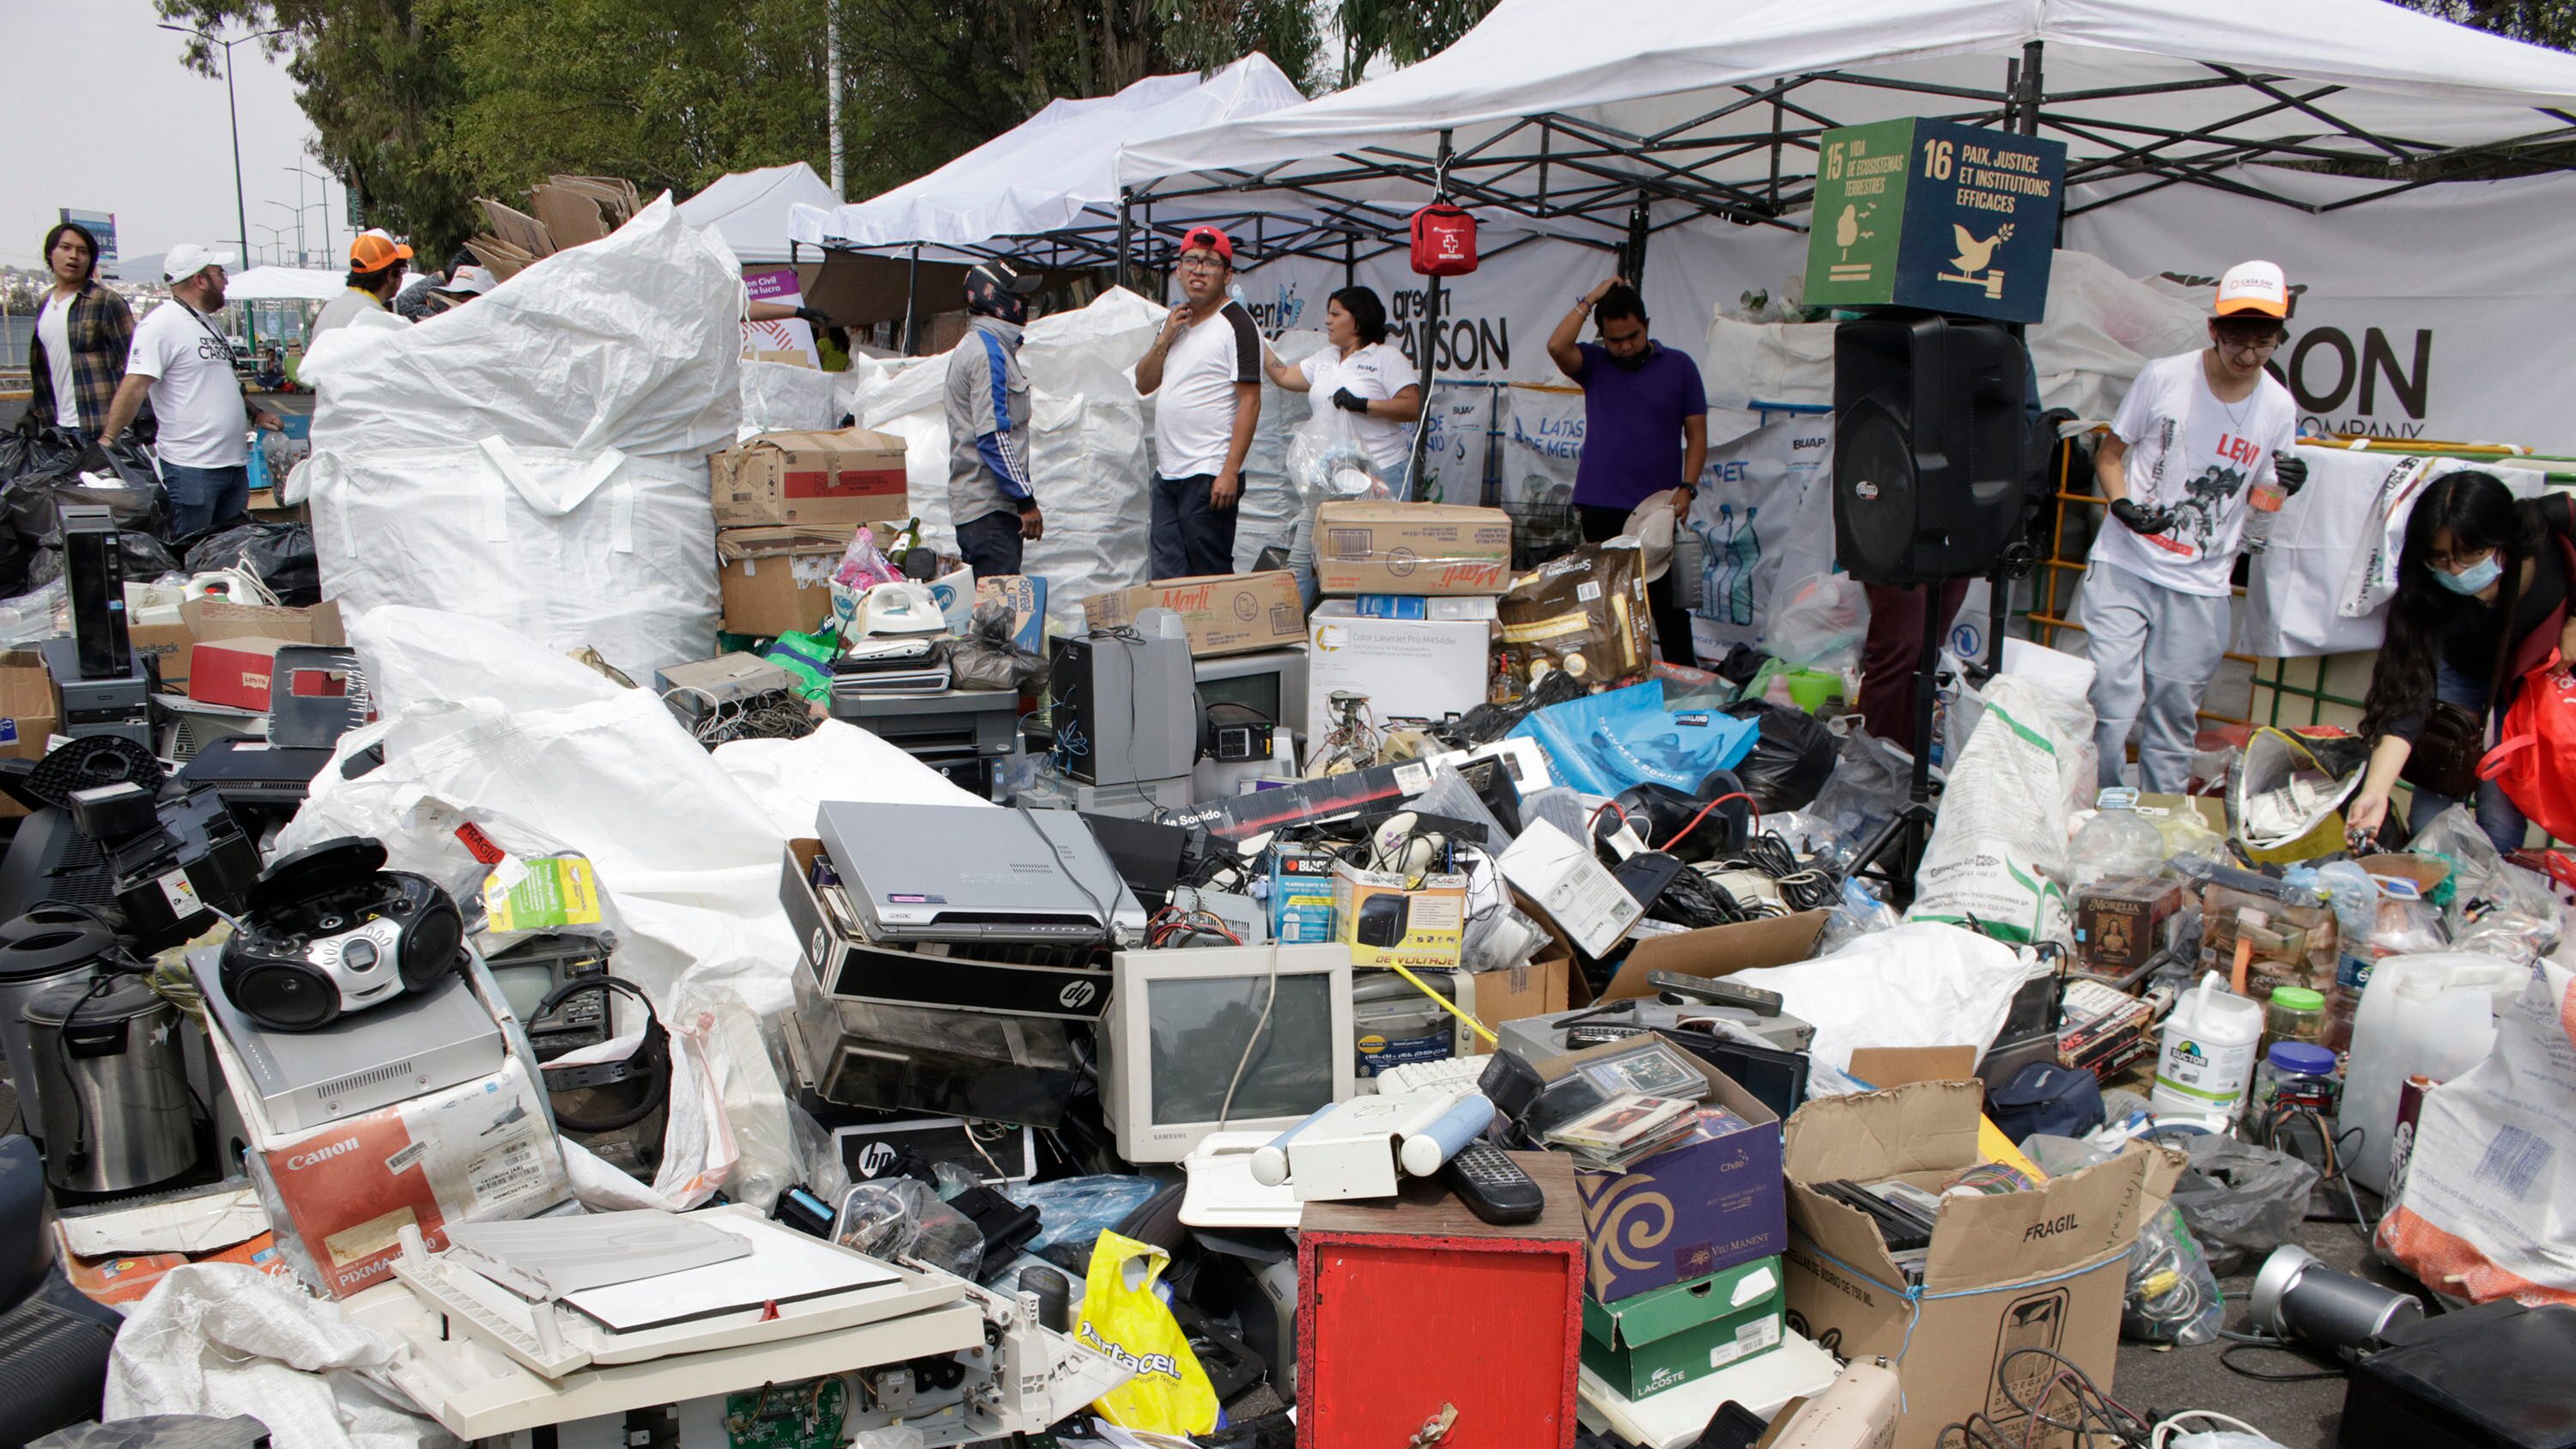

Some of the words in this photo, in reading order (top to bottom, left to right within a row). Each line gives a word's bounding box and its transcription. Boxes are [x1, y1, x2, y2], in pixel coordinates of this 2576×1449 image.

[1826, 143, 1844, 180] 15
[1850, 139, 1866, 158] VIDA
[1846, 160, 1856, 178] DE
[1856, 154, 1904, 174] ECOSISTEMAS
[1924, 138, 1953, 180] 16
[1962, 144, 1991, 167] PAIX,
[1993, 150, 2040, 174] JUSTICE
[1845, 176, 1886, 197] TERRESTRES
[1959, 167, 1974, 185] ET
[1975, 169, 2050, 198] INSTITUTIONS
[1956, 188, 2015, 214] EFFICACES
[758, 275, 777, 286] Civil
[760, 284, 781, 294] lucro
[1393, 288, 1450, 330] gren
[1540, 417, 1584, 437] LATAS
[1547, 441, 1583, 460] MET
[1793, 438, 1826, 450] BUAP
[2216, 433, 2260, 468] LEVI
[1018, 580, 1034, 612] Boreal
[1161, 589, 1210, 612] Marli
[1352, 632, 1374, 642] Color
[1375, 632, 1406, 644] LaserJet
[1407, 635, 1422, 644] Pro
[1423, 635, 1456, 645] M454dw
[1549, 764, 1571, 787] NATU
[1641, 764, 1684, 782] DOMAIN
[1179, 809, 1221, 827] Sonido
[460, 825, 496, 861] FRAGIL
[2087, 898, 2141, 912] MORELIA
[1376, 955, 1392, 965] DE
[1398, 955, 1456, 965] VOLTAJE
[2172, 1048, 2207, 1066] SUCTOR
[1153, 1131, 1188, 1141] SAMSUNG
[287, 1136, 361, 1172] Canon
[1721, 1160, 1745, 1172] Chile
[2022, 1213, 2079, 1244] FRAGIL
[1729, 1233, 1770, 1251] MANENT
[338, 1252, 390, 1288] PIXMA
[1820, 1266, 1842, 1292] VIDRIO
[1842, 1280, 1852, 1295] DE
[1637, 1370, 1686, 1397] LACOSTE
